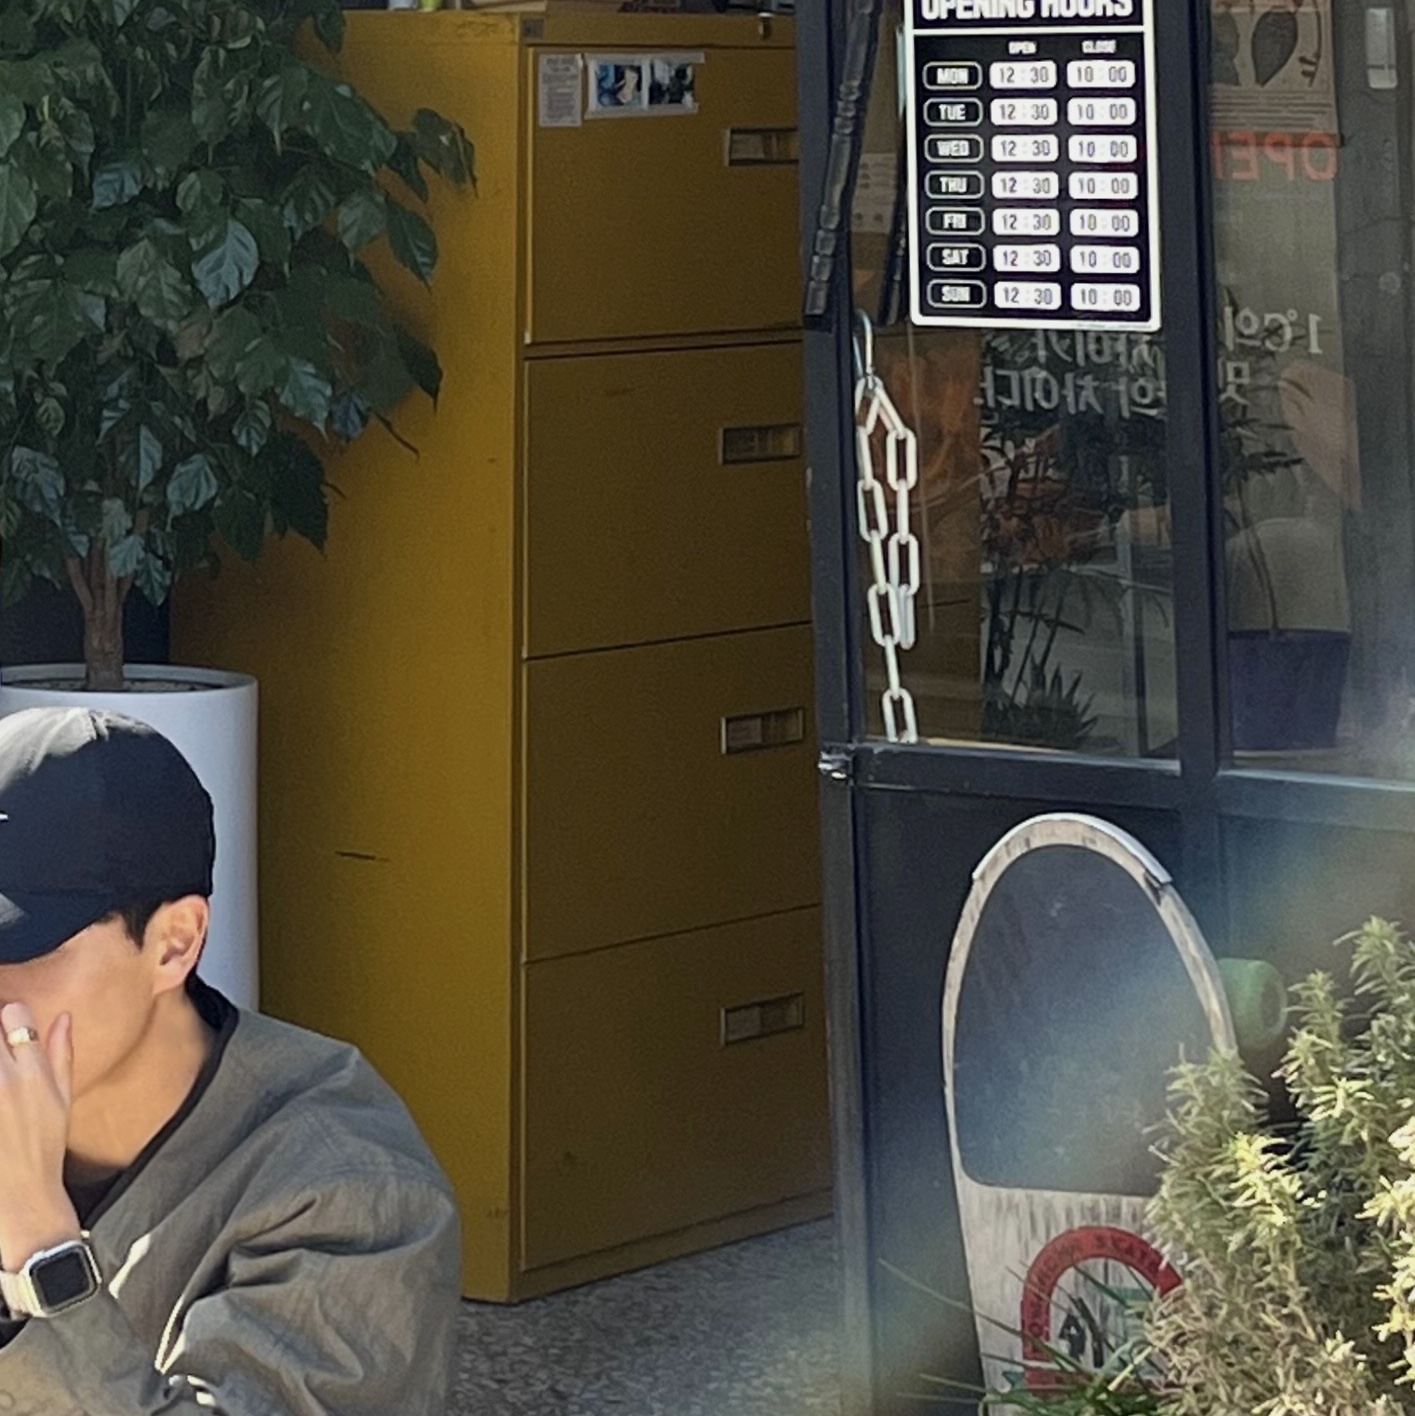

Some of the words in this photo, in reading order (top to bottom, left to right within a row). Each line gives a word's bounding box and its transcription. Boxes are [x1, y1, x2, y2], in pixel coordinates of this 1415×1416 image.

[936, 68, 970, 85] MON
[938, 103, 967, 121] TUE
[941, 249, 970, 266] SAT
